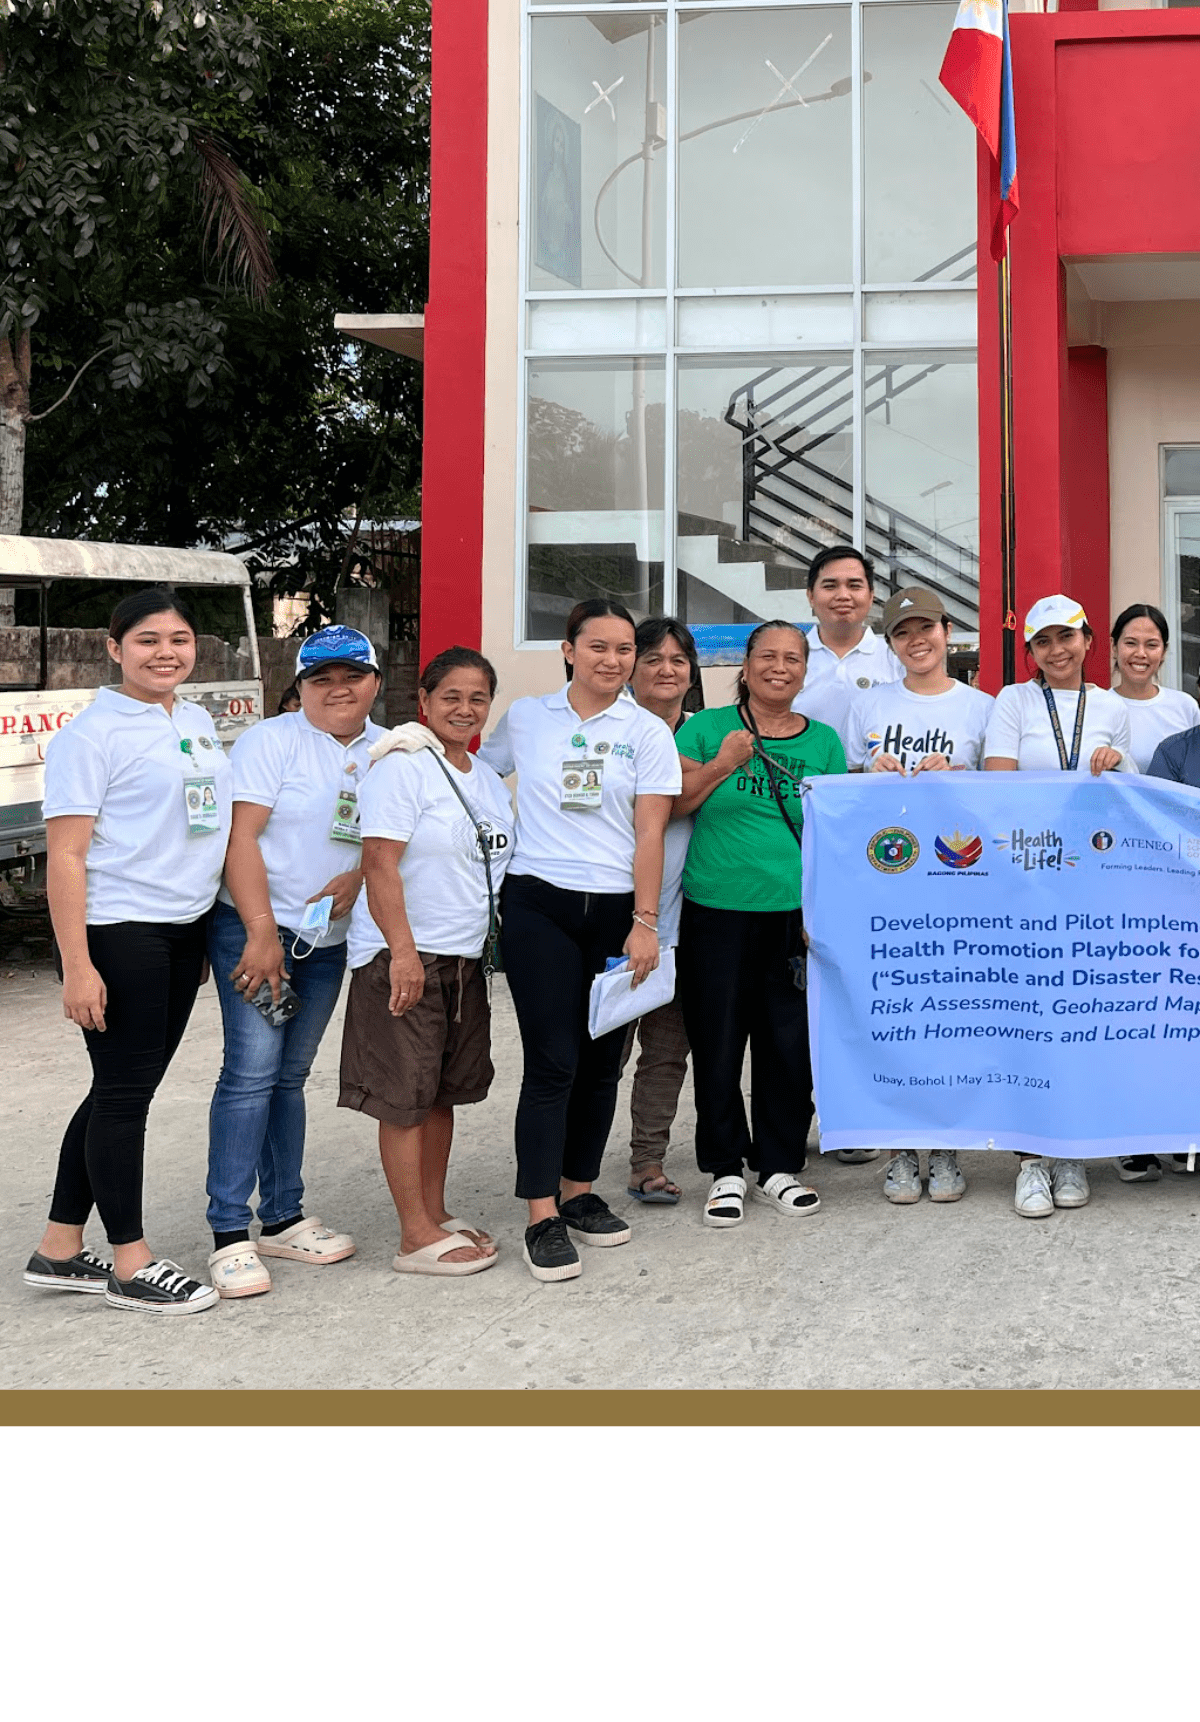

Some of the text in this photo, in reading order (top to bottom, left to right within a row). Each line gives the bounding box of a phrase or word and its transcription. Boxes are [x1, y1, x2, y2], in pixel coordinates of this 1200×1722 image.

[884, 724, 954, 754] Health
[1012, 828, 1063, 850] Health
[1121, 838, 1173, 852] ATENEO
[1012, 848, 1063, 871] is Life!
[1101, 863, 1132, 871] Forming
[1167, 867, 1196, 877] Leading
[871, 913, 1013, 932] Development
[1020, 915, 1057, 931] and
[1066, 914, 1114, 930] Pilot
[871, 940, 945, 960] Health
[954, 939, 1063, 959] Promotion
[1072, 940, 1171, 961] Playbook
[872, 966, 1019, 991] (“Sustainable
[1025, 970, 1064, 987] and
[1073, 968, 1162, 985] Disaster
[871, 998, 913, 1015] Risk
[920, 996, 1043, 1017] Assessment,
[1052, 996, 1158, 1015] Geohazard
[872, 1025, 916, 1041] with
[924, 1023, 1053, 1043] Homeowners
[1060, 1026, 1097, 1043] and
[1104, 1024, 1156, 1040] Local
[874, 1073, 905, 1087] Ubay,
[909, 1075, 945, 1086] Bohol
[957, 1075, 982, 1085] May
[987, 1073, 1020, 1086] 13-17,
[1024, 1076, 1050, 1089] 2024
